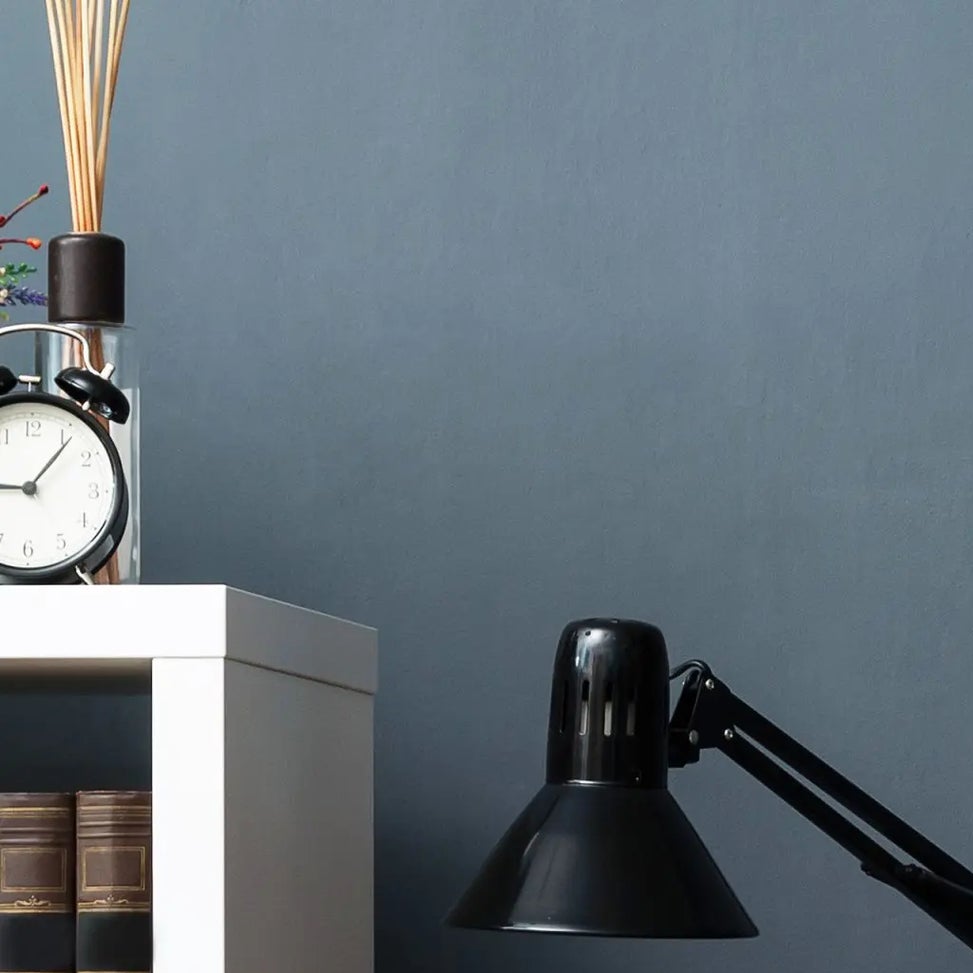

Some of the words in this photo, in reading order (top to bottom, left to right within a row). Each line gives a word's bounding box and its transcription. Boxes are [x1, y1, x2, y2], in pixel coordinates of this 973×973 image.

[26, 420, 41, 437] 12
[60, 428, 65, 445] 1
[80, 450, 92, 467] 2
[88, 482, 99, 500] 3
[22, 539, 34, 558] 6
[56, 533, 67, 549] 5
